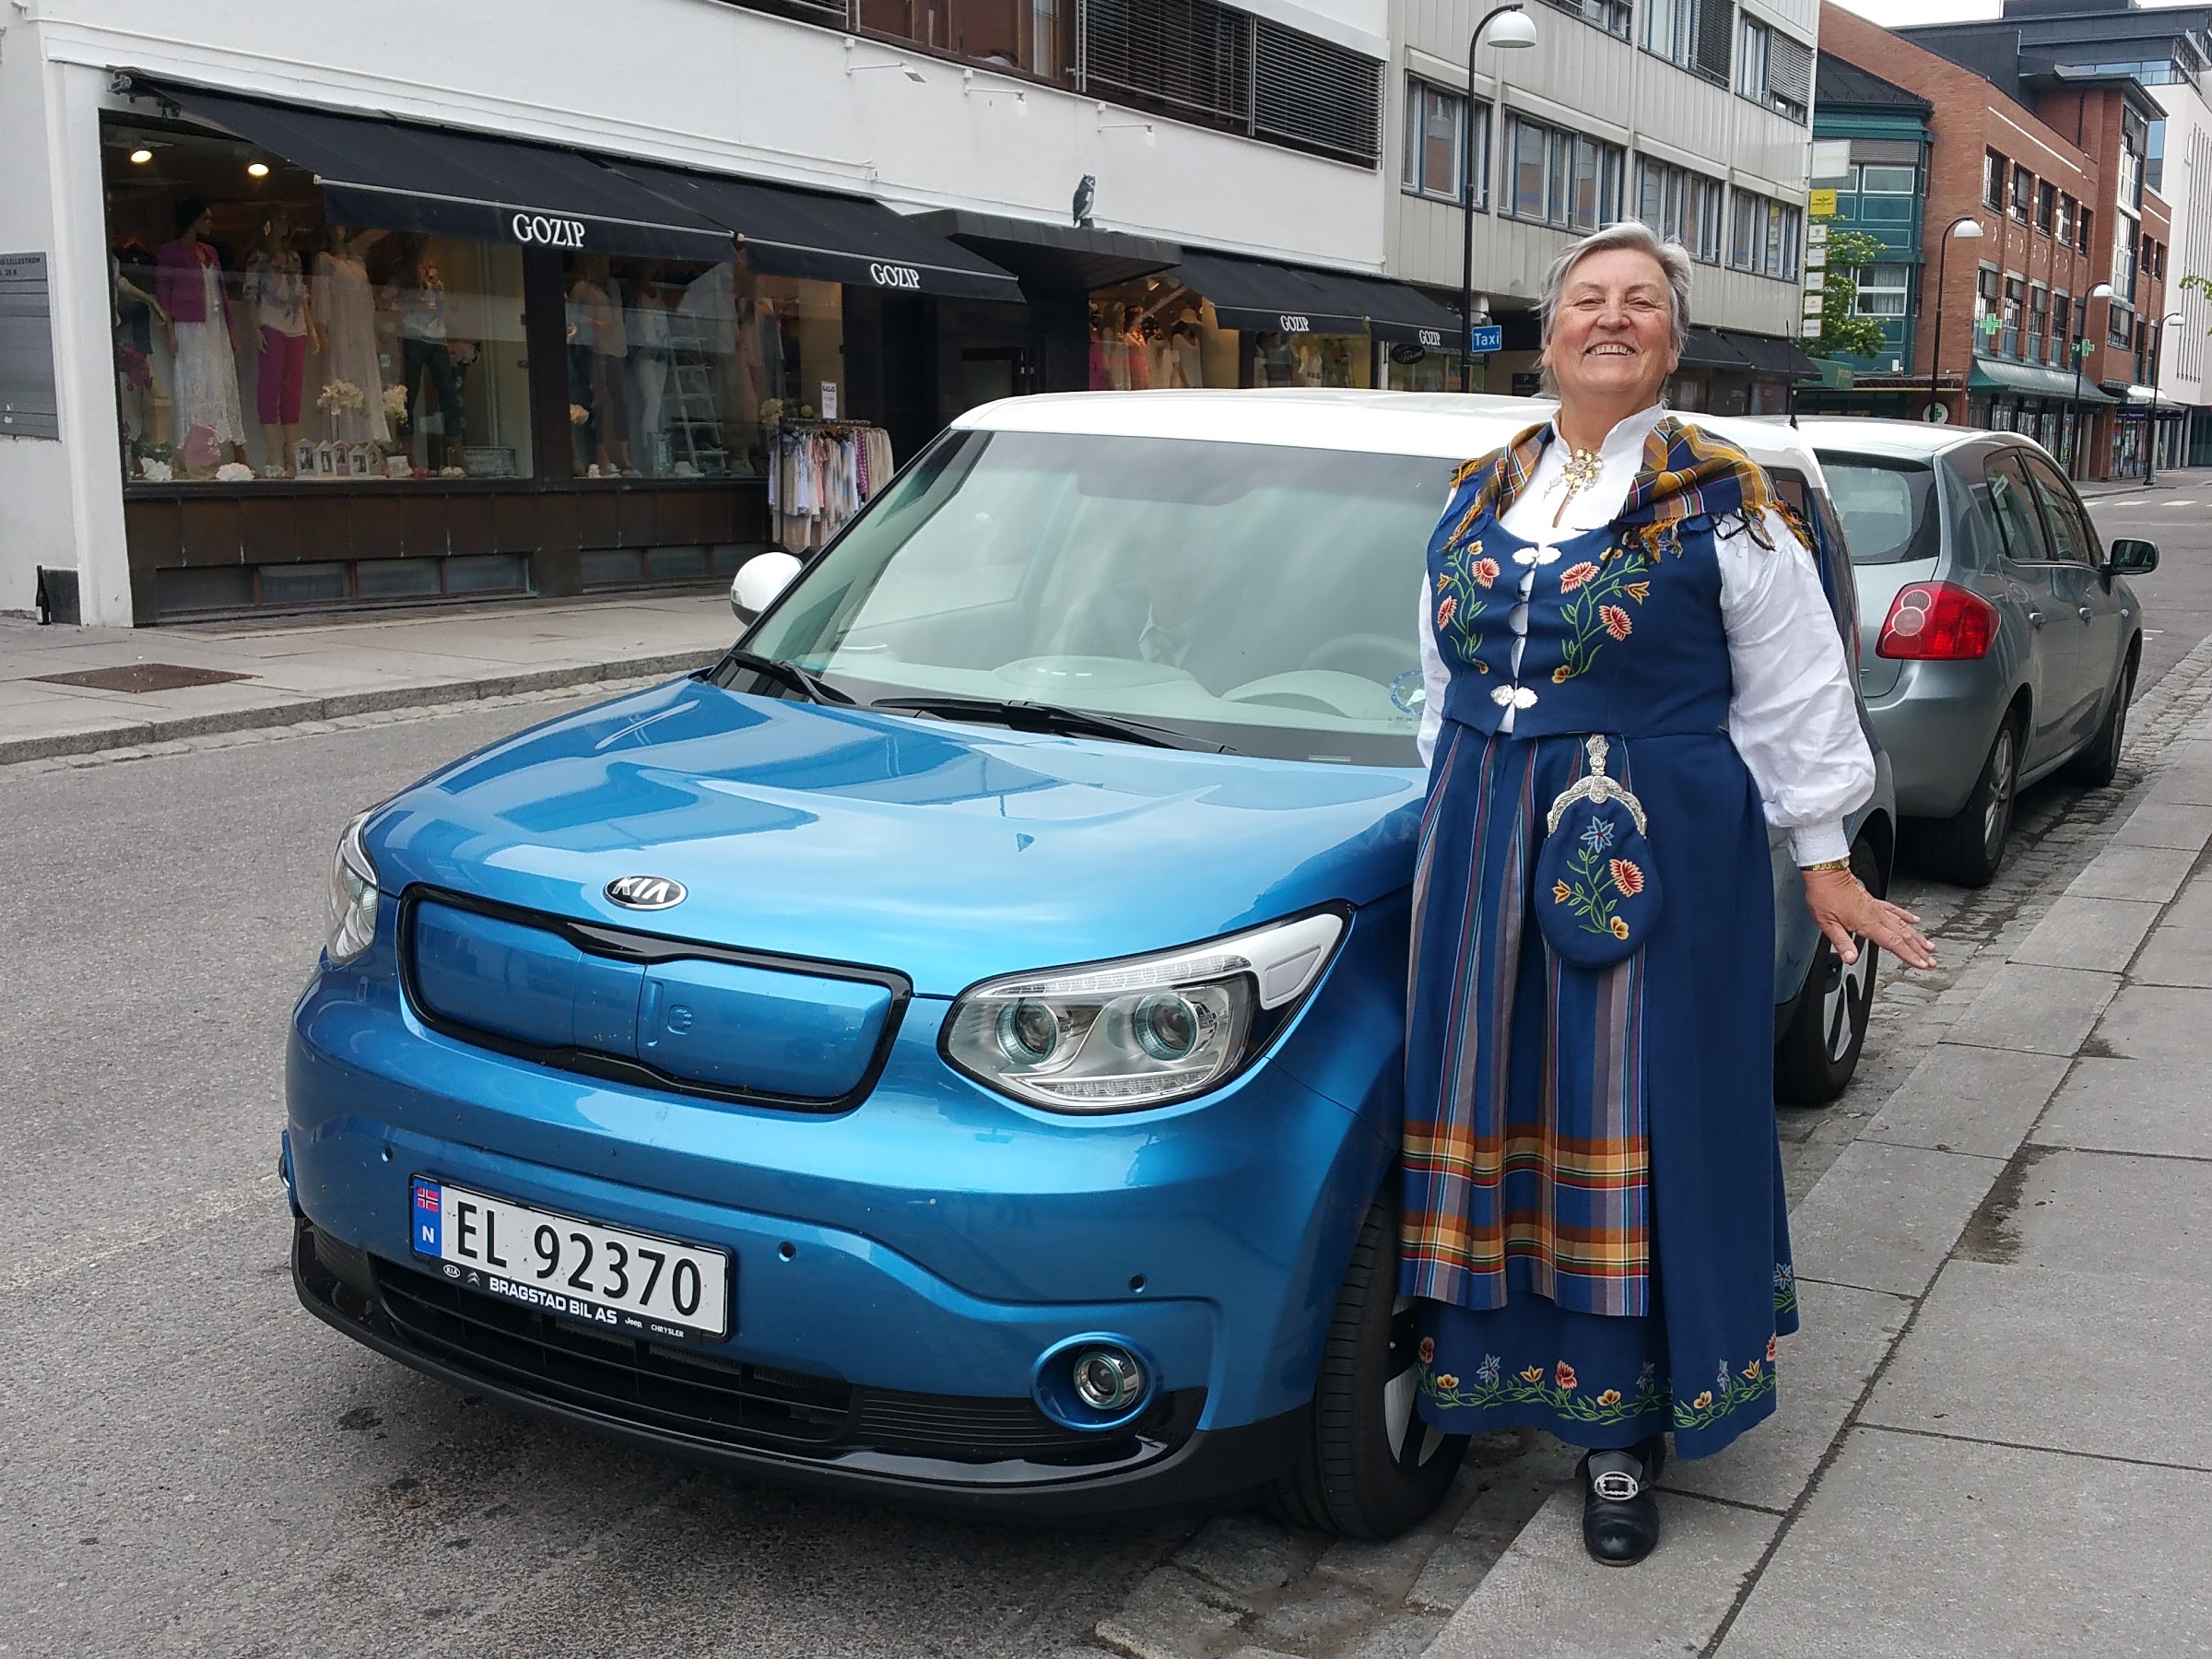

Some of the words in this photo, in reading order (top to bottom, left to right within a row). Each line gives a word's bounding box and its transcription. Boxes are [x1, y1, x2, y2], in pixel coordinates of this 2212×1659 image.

[512, 213, 585, 248] GOZIP
[870, 263, 921, 288] GOZIP
[1280, 315, 1310, 332] GOZIP
[1419, 329, 1441, 346] GOZIP
[1475, 332, 1500, 347] Taxi
[612, 878, 670, 902] KIA
[422, 1225, 435, 1244] N
[458, 1200, 507, 1269] EL
[534, 1224, 701, 1316] 92370
[445, 1266, 459, 1277] KIA
[489, 1276, 566, 1312] BRAGSTAD
[570, 1300, 593, 1319] BIL
[594, 1307, 618, 1324] AS
[625, 1316, 643, 1328] Jeep
[651, 1324, 685, 1338] CHRYSLER
